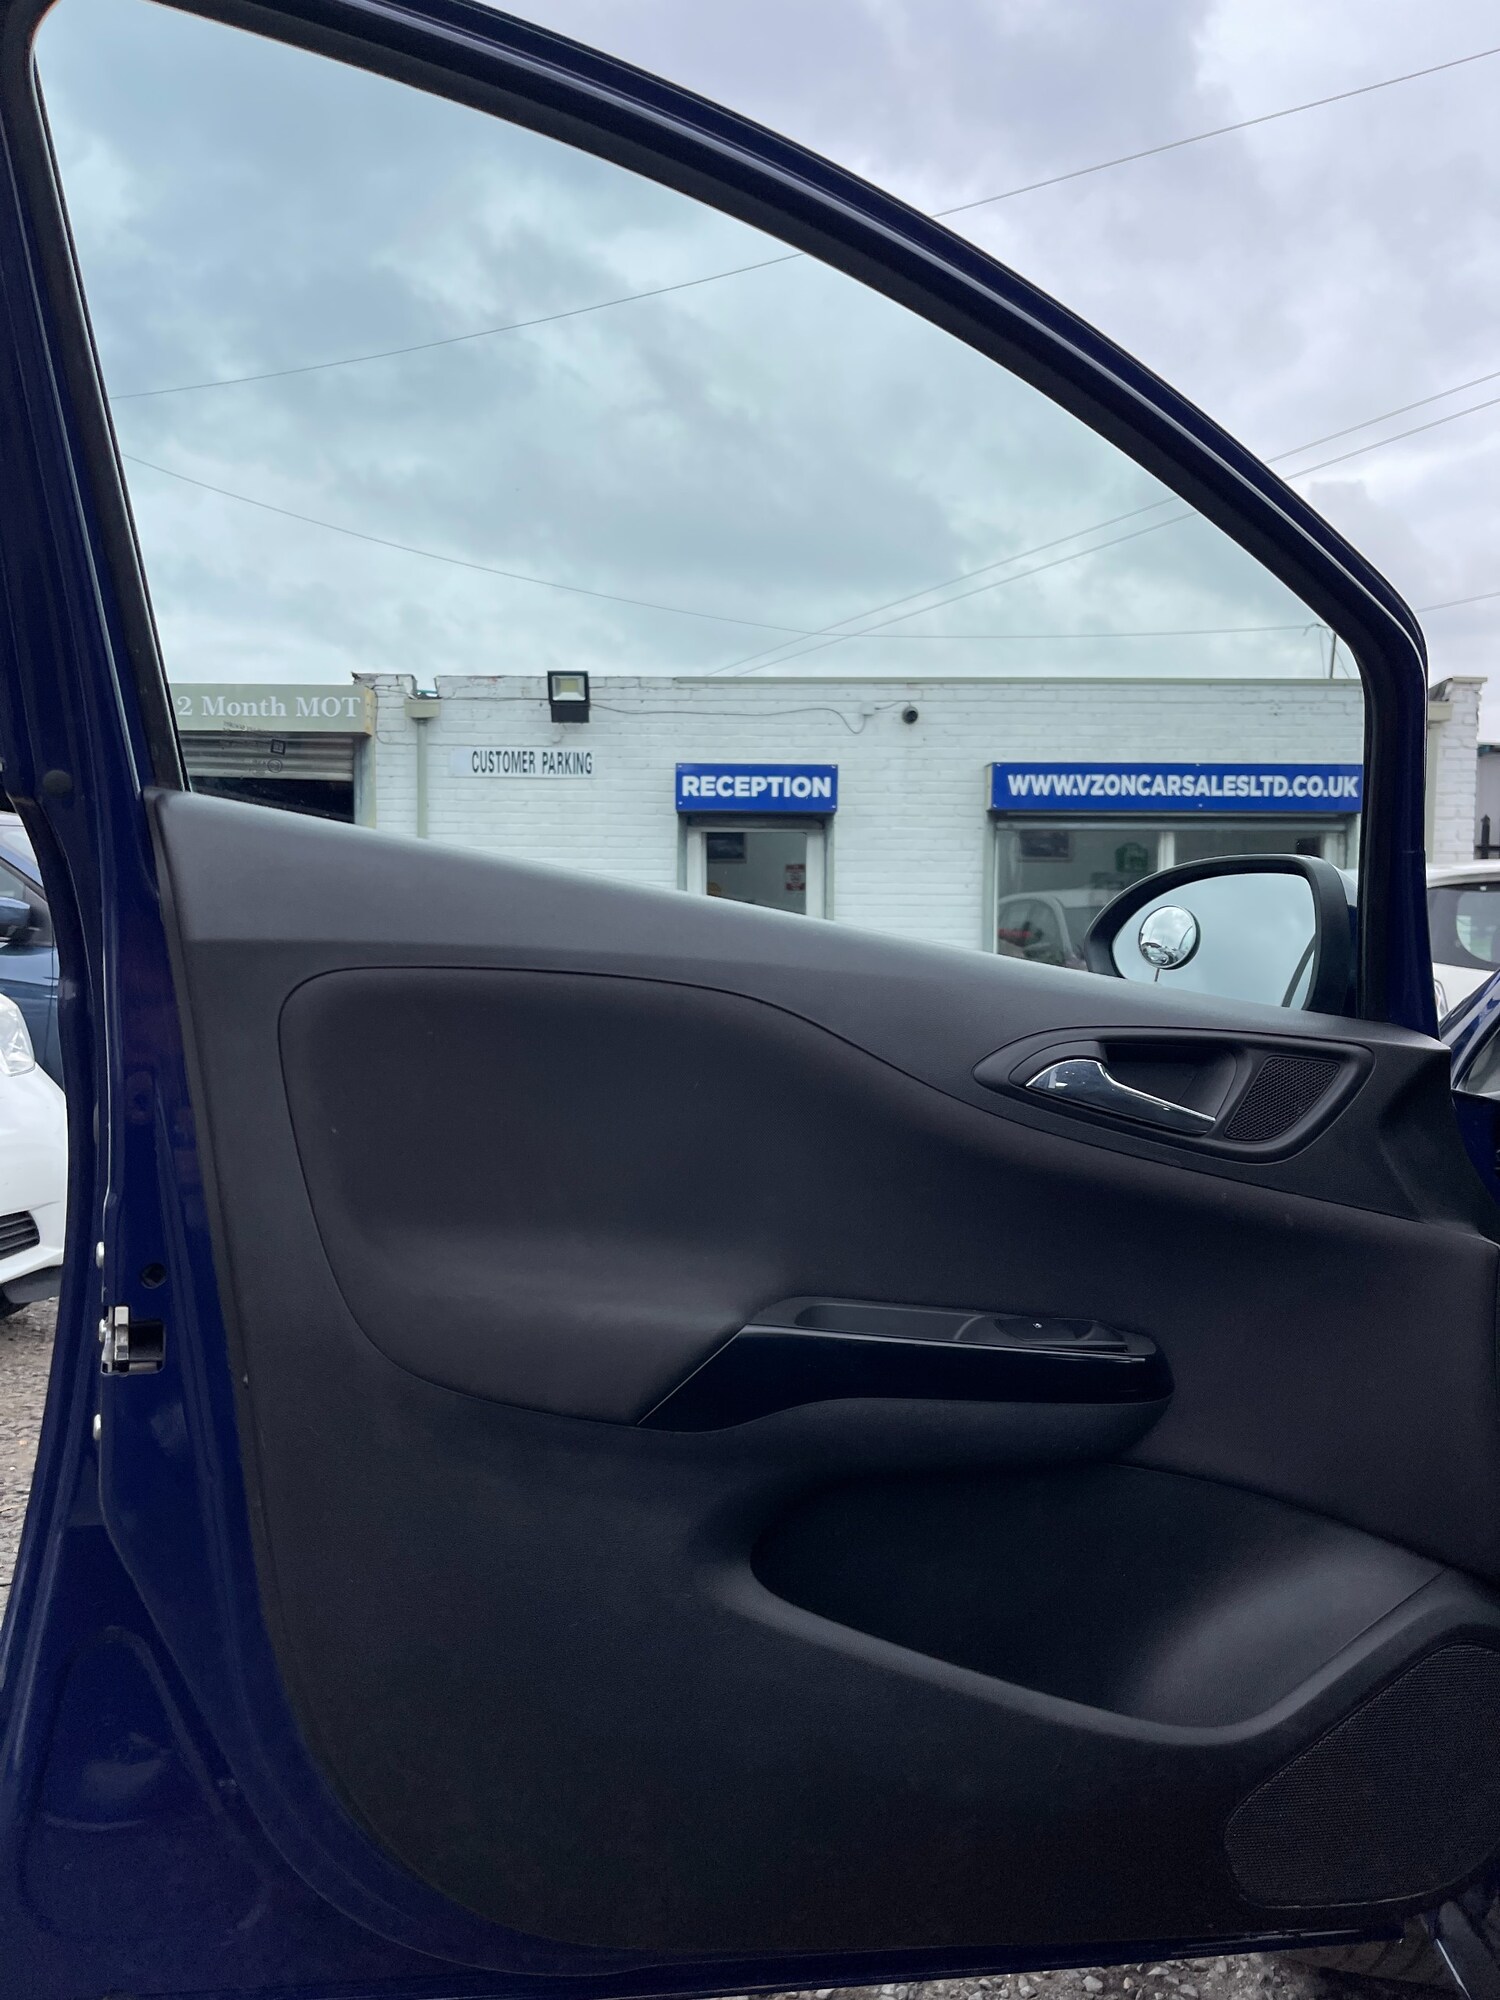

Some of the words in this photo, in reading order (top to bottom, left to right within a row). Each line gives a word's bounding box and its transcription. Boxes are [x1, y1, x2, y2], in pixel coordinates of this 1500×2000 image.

[201, 696, 287, 717] Month
[295, 696, 361, 718] MOT
[471, 750, 536, 774] CUSTOMER
[542, 751, 593, 775] PARKING
[681, 775, 832, 798] RECEPTION
[1007, 774, 1360, 798] WWW.VZONCARSALESLTD.CO.UK
